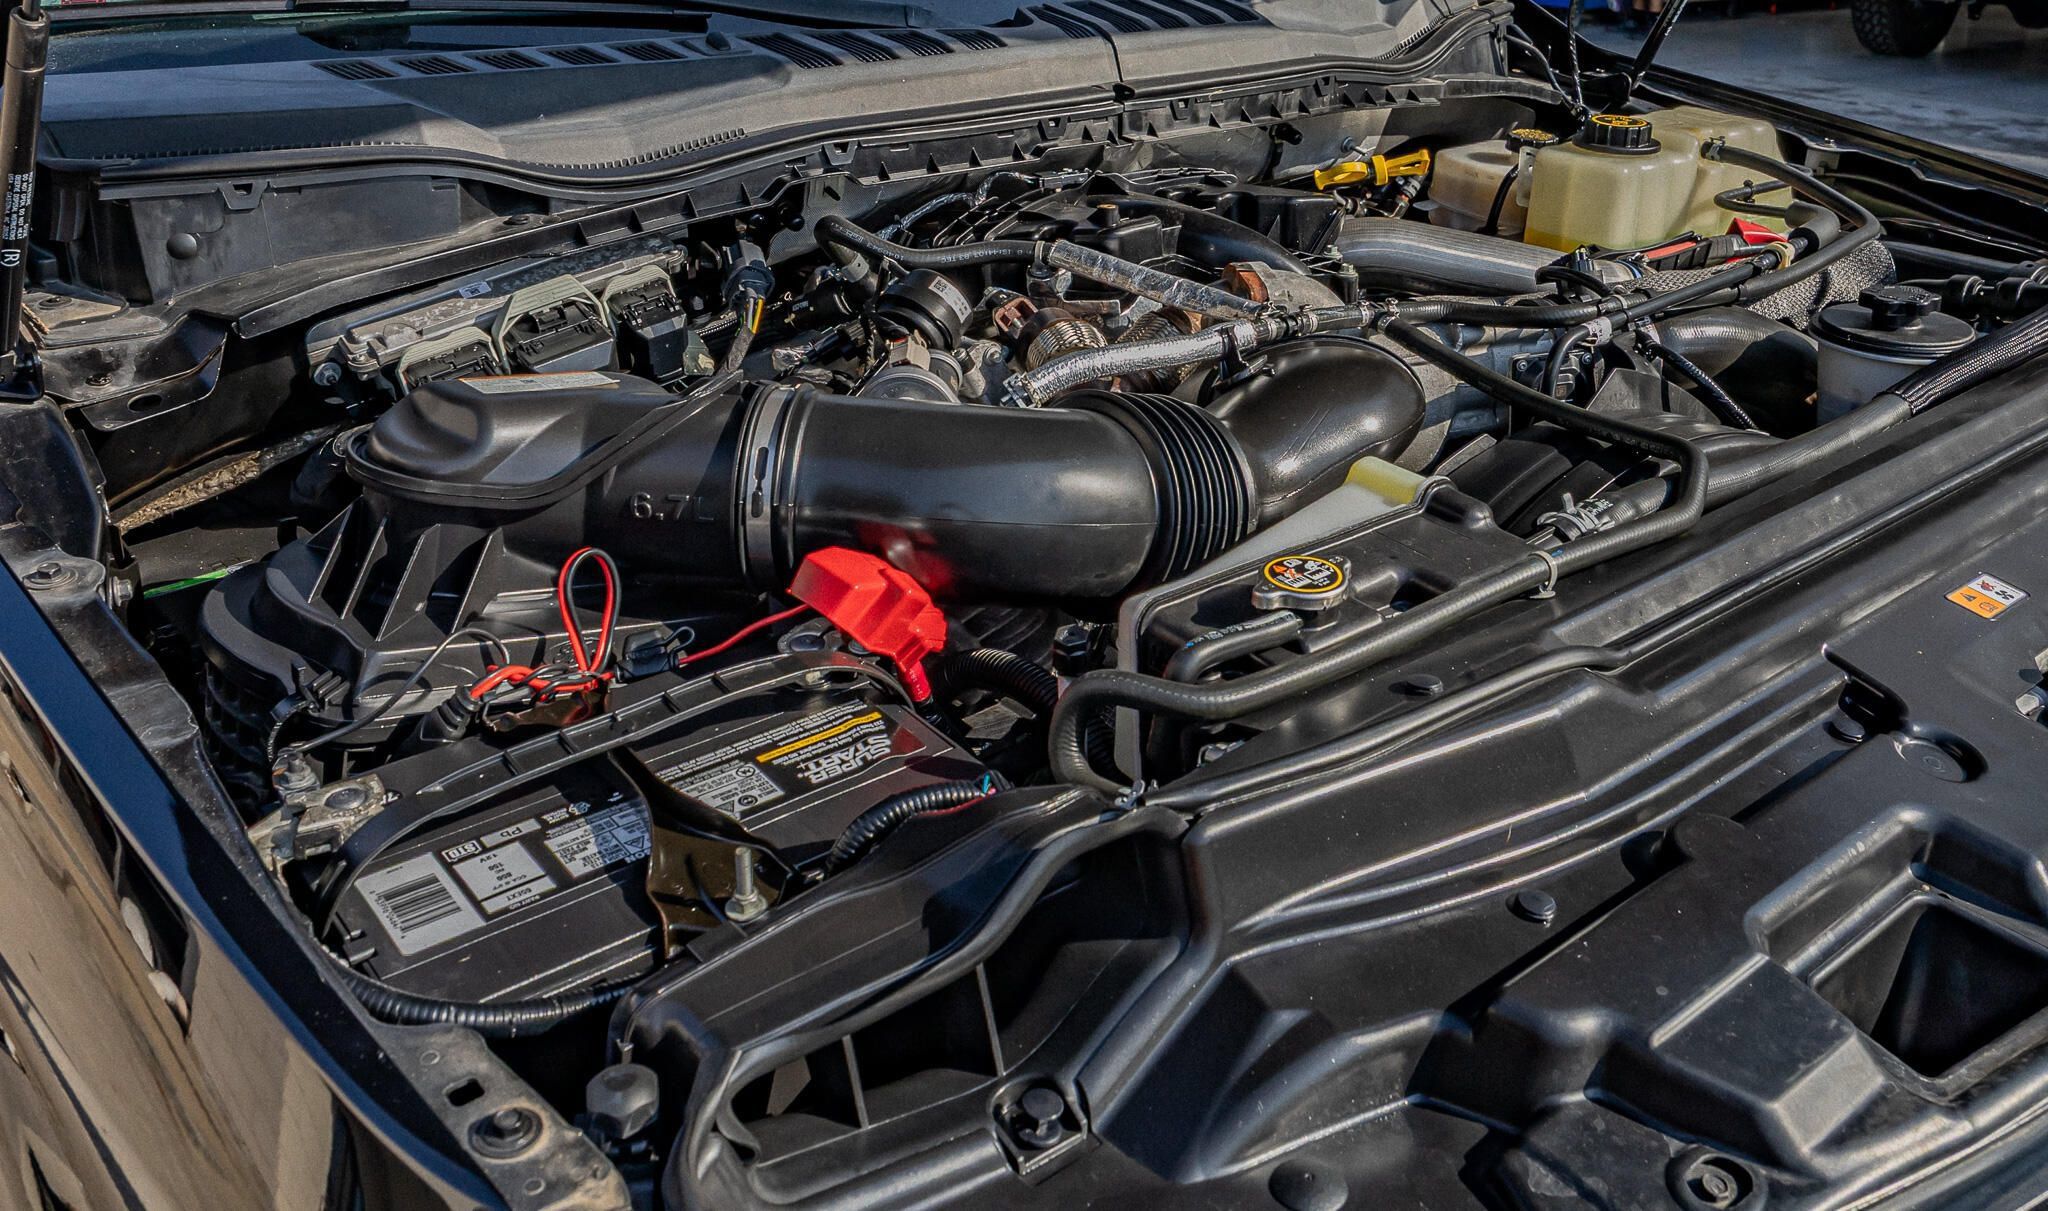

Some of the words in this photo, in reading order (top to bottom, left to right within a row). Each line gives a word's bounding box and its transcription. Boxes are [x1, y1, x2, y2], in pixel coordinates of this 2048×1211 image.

[810, 746, 891, 784] SUPER
[500, 826, 523, 838] Pb
[480, 853, 499, 863] 12V
[506, 887, 532, 902] 65EXT
